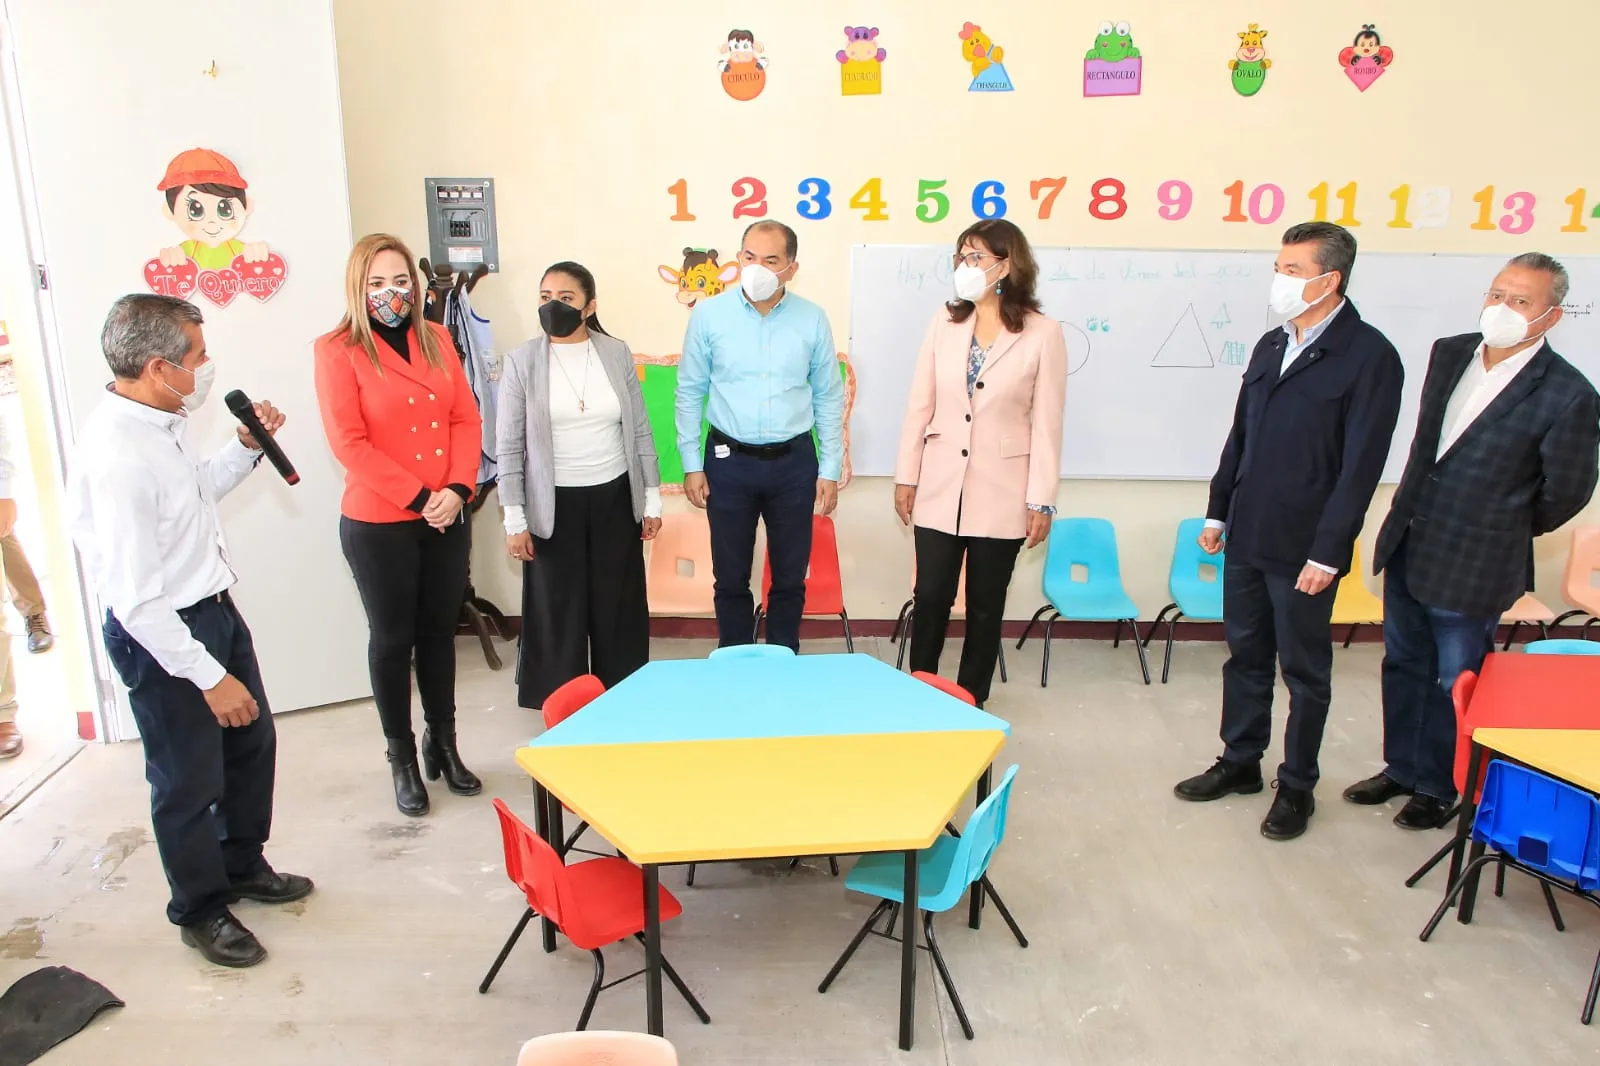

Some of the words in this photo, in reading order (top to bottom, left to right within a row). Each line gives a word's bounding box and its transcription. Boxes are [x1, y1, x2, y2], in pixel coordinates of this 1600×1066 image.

[1086, 70, 1136, 81] RECTANGULO
[1236, 69, 1262, 79] OVALO
[668, 178, 696, 222] 1
[732, 178, 768, 219] 2
[797, 178, 832, 220] 3
[849, 177, 889, 222] 4
[916, 179, 950, 223] 5
[972, 180, 1007, 219] 6
[1030, 176, 1067, 220] 7
[1089, 178, 1127, 221] 8
[1157, 180, 1193, 221] 9
[1223, 180, 1285, 224] 10
[1307, 181, 1361, 227] 11
[1471, 185, 1535, 234] 13
[153, 274, 192, 297] Te
[197, 271, 281, 300] Quiero
